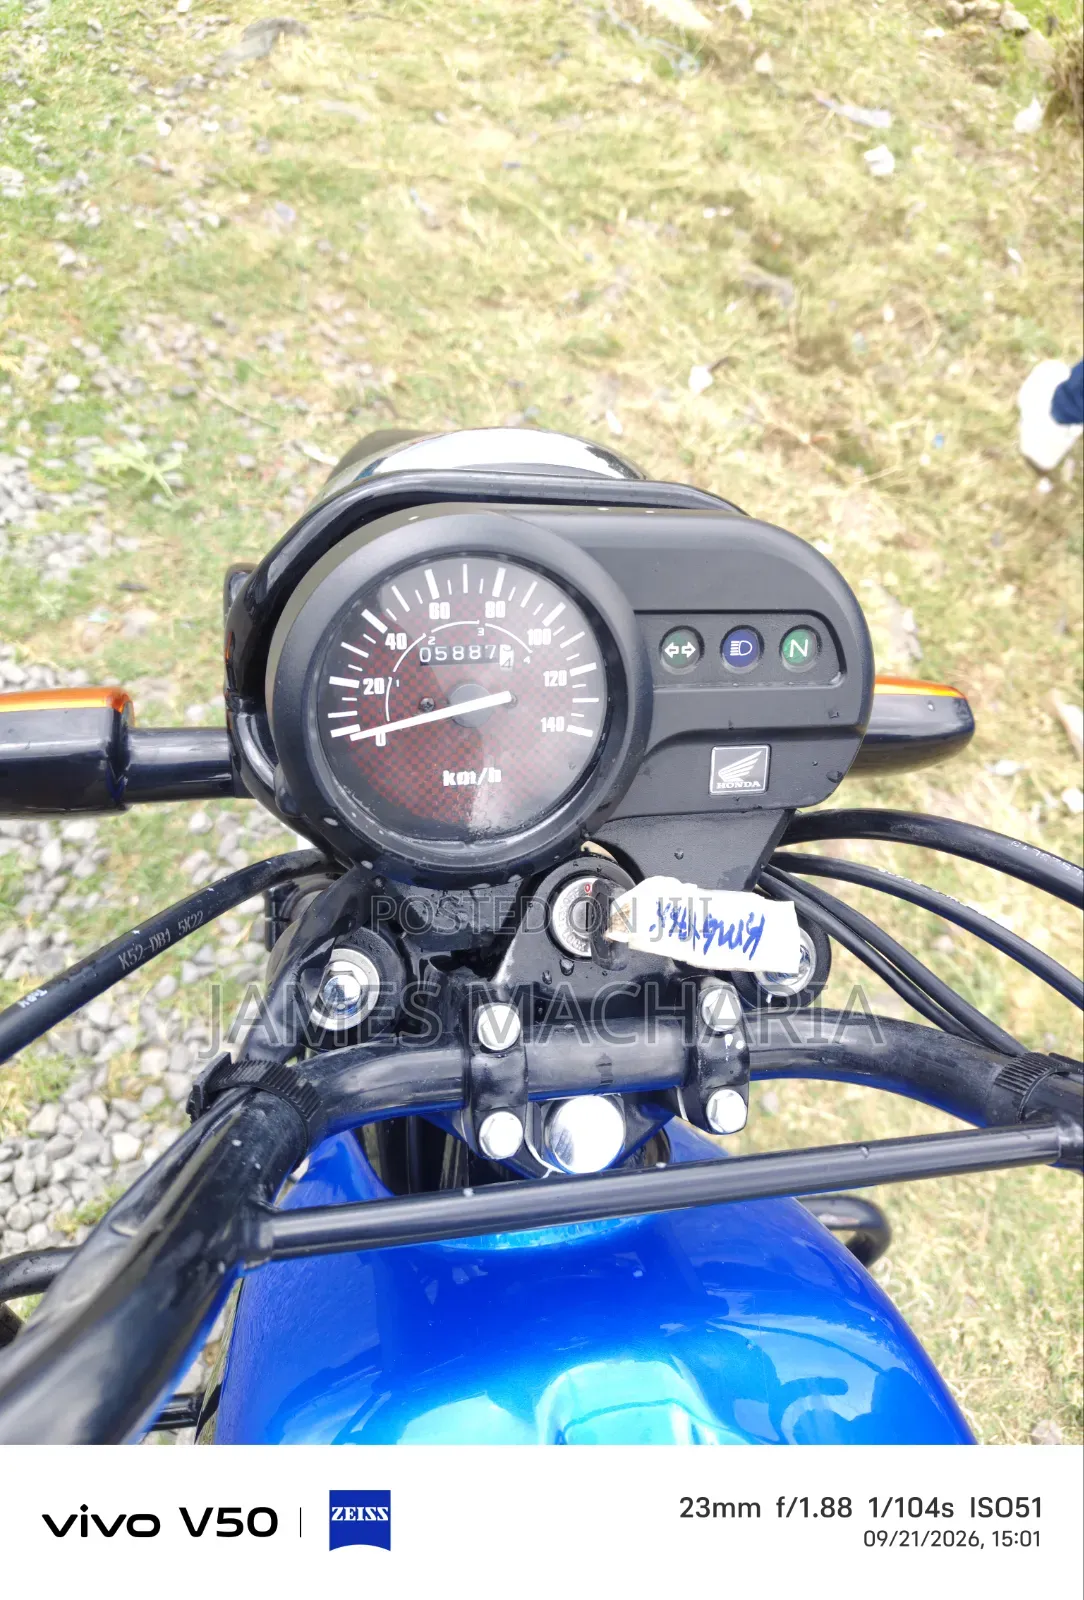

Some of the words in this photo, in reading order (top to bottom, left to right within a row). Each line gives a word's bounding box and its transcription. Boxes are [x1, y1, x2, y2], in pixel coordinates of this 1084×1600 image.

[428, 602, 451, 620] 60
[485, 600, 506, 619] 80
[477, 627, 485, 636] 3
[527, 628, 551, 646] 100
[385, 633, 407, 650] 40
[427, 636, 436, 646] 2
[789, 638, 809, 658] N
[523, 655, 531, 665] 4
[363, 677, 385, 695] 20
[543, 670, 567, 687] 120
[540, 716, 565, 733] 140
[375, 730, 387, 747] 0
[443, 768, 502, 787] km/h
[716, 780, 761, 790] HONDA
